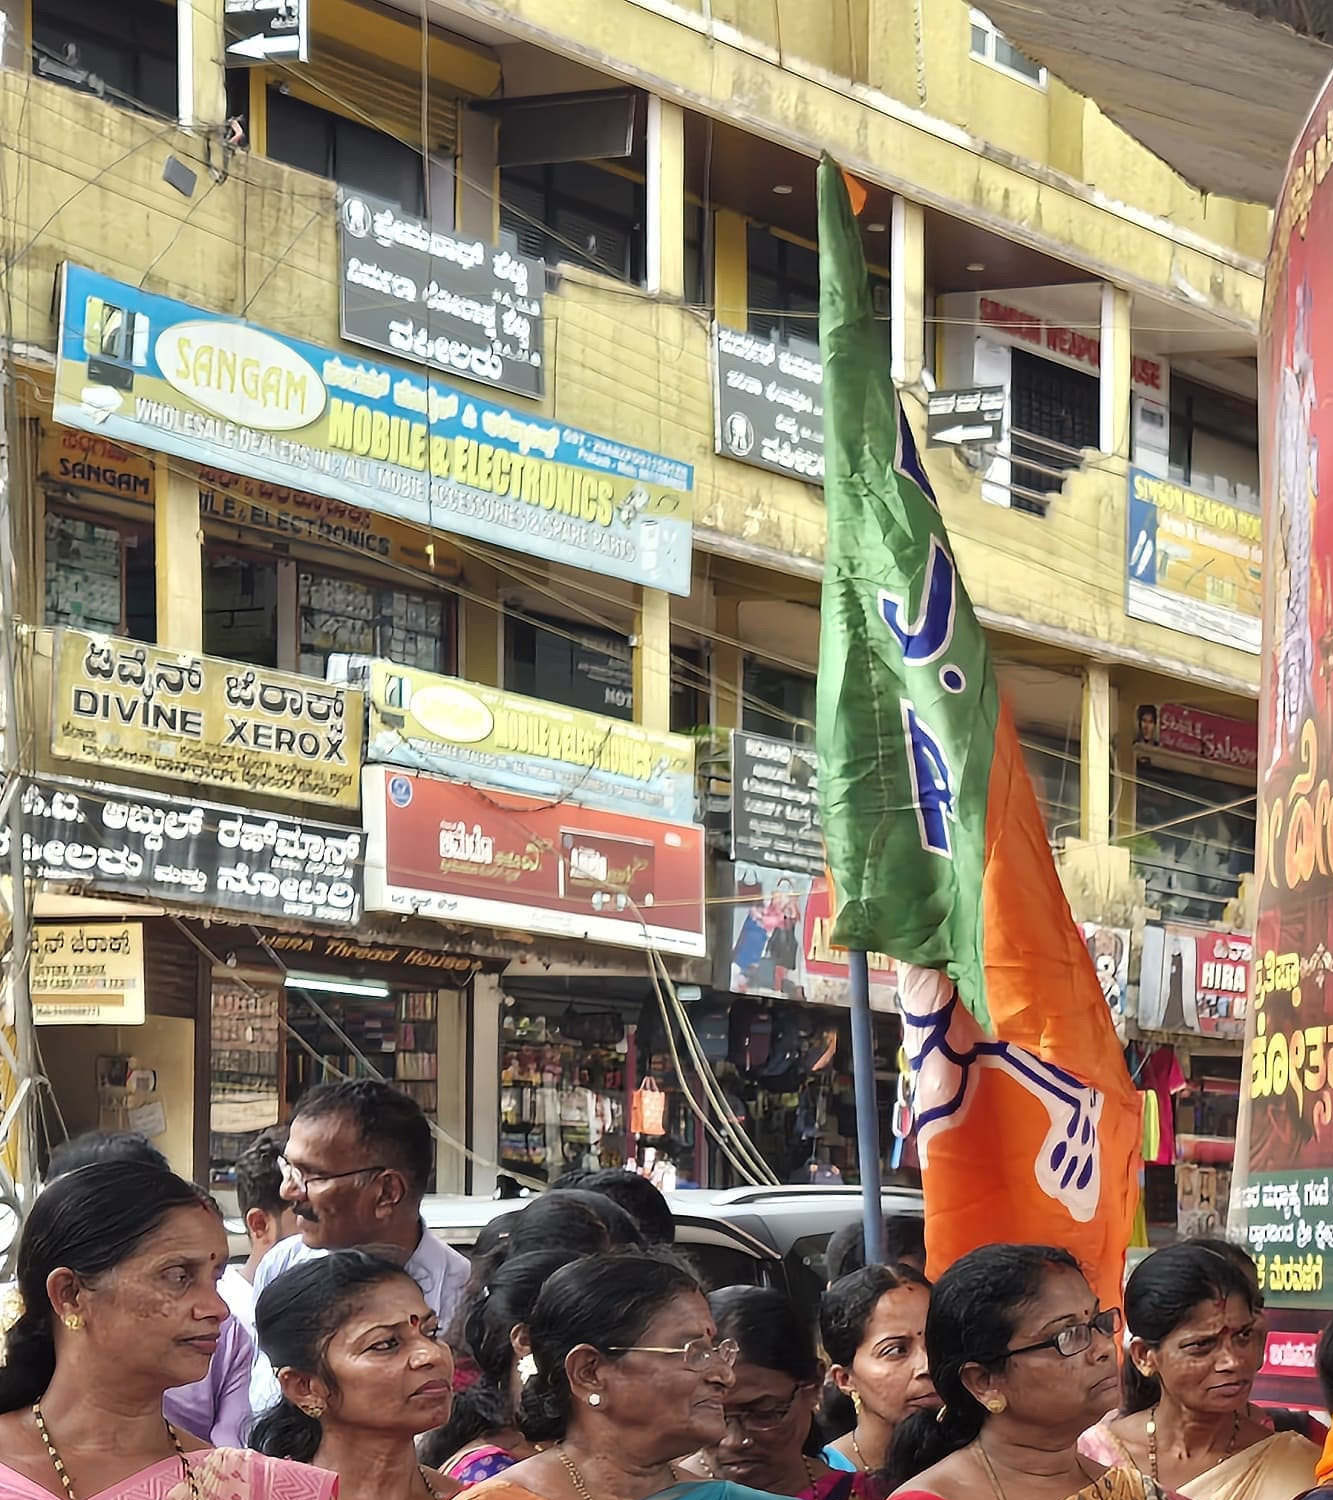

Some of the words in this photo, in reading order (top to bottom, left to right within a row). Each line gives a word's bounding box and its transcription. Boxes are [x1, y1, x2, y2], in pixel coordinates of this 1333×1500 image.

[176, 337, 308, 414] SANGAM
[59, 457, 150, 496] SANGAM
[328, 397, 427, 472] MOBILE
[453, 436, 614, 527] ELECTRONICS
[72, 687, 203, 735] DIVINE
[224, 716, 347, 764] XEROX
[1200, 960, 1247, 993] HIRA
